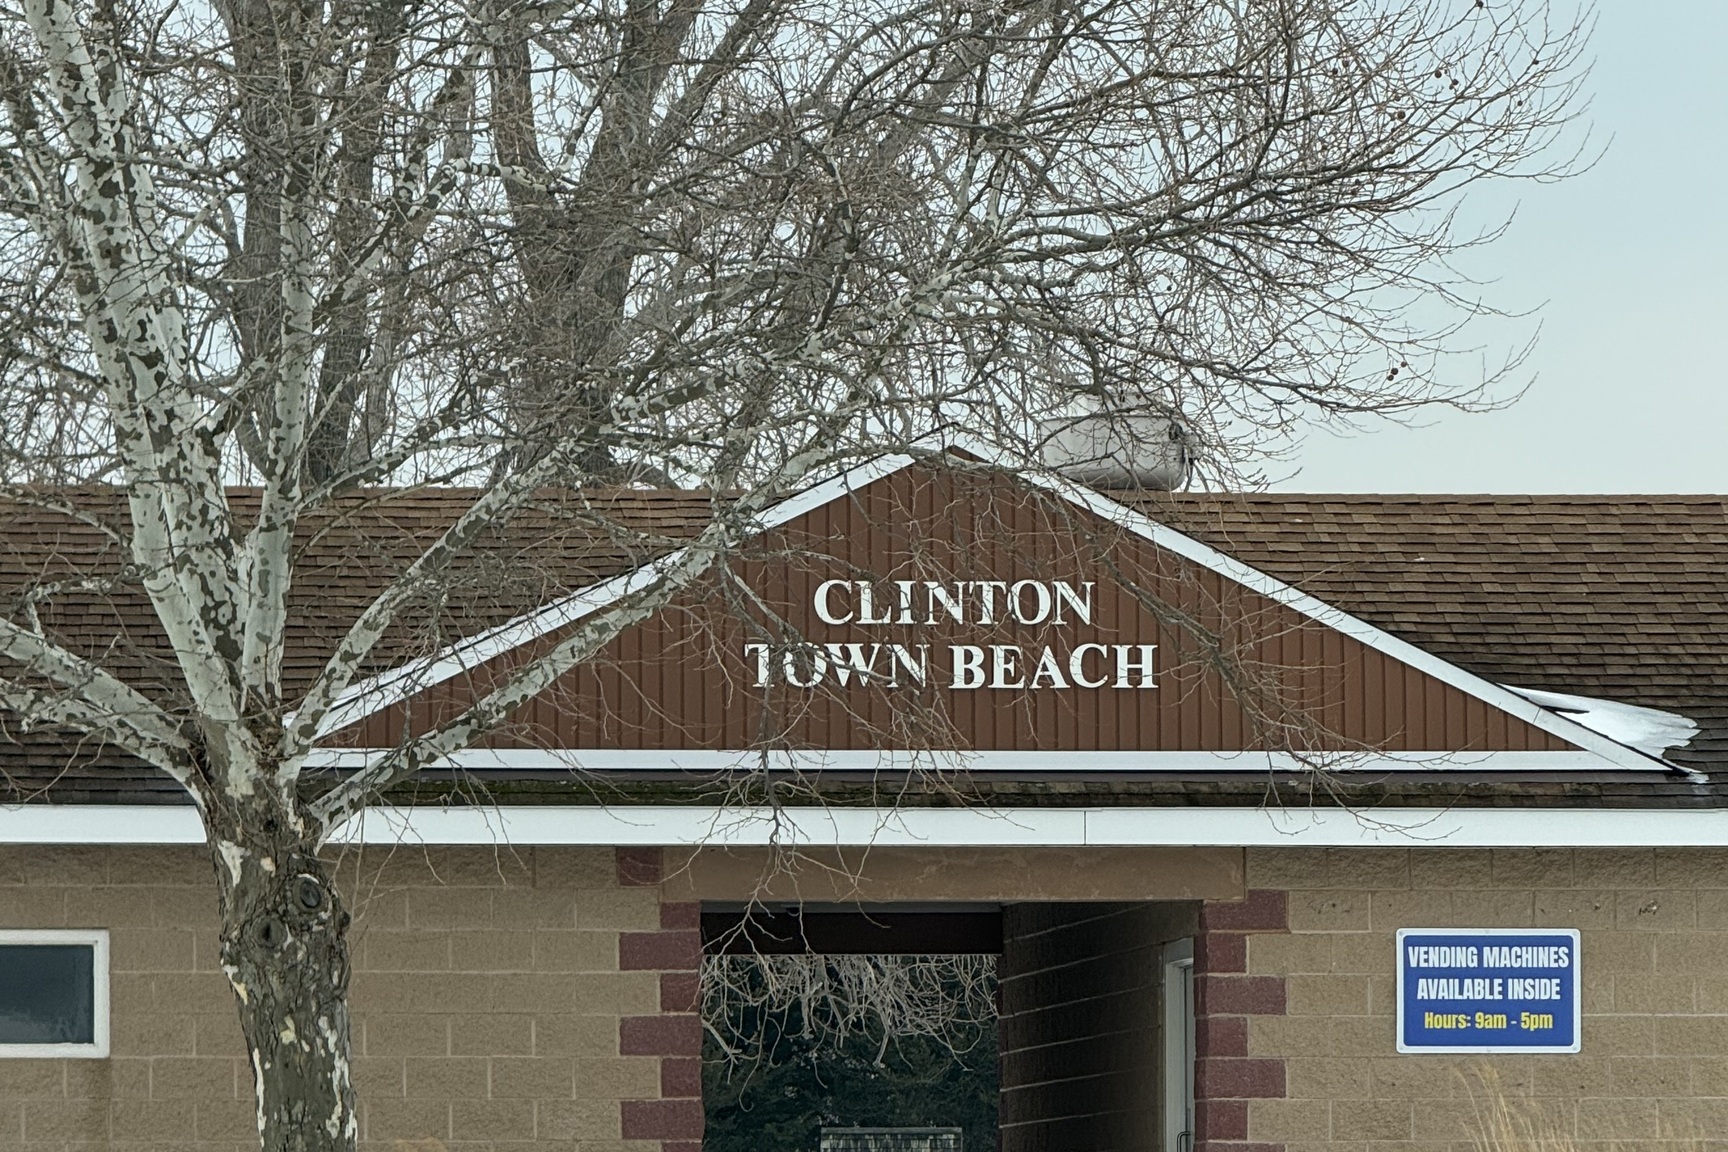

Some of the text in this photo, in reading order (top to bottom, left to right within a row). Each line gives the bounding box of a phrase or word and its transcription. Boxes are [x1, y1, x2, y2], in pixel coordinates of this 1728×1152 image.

[813, 579, 1096, 626] CLINTON
[744, 642, 1159, 689] TOWN BEACH
[1408, 946, 1570, 968] VENDING MACHINES
[1417, 978, 1561, 1000] AVAILABLE INSIDE
[1424, 1012, 1471, 1029] Hours:
[1475, 1012, 1507, 1029] 9am
[1521, 1012, 1553, 1031] 5pm
